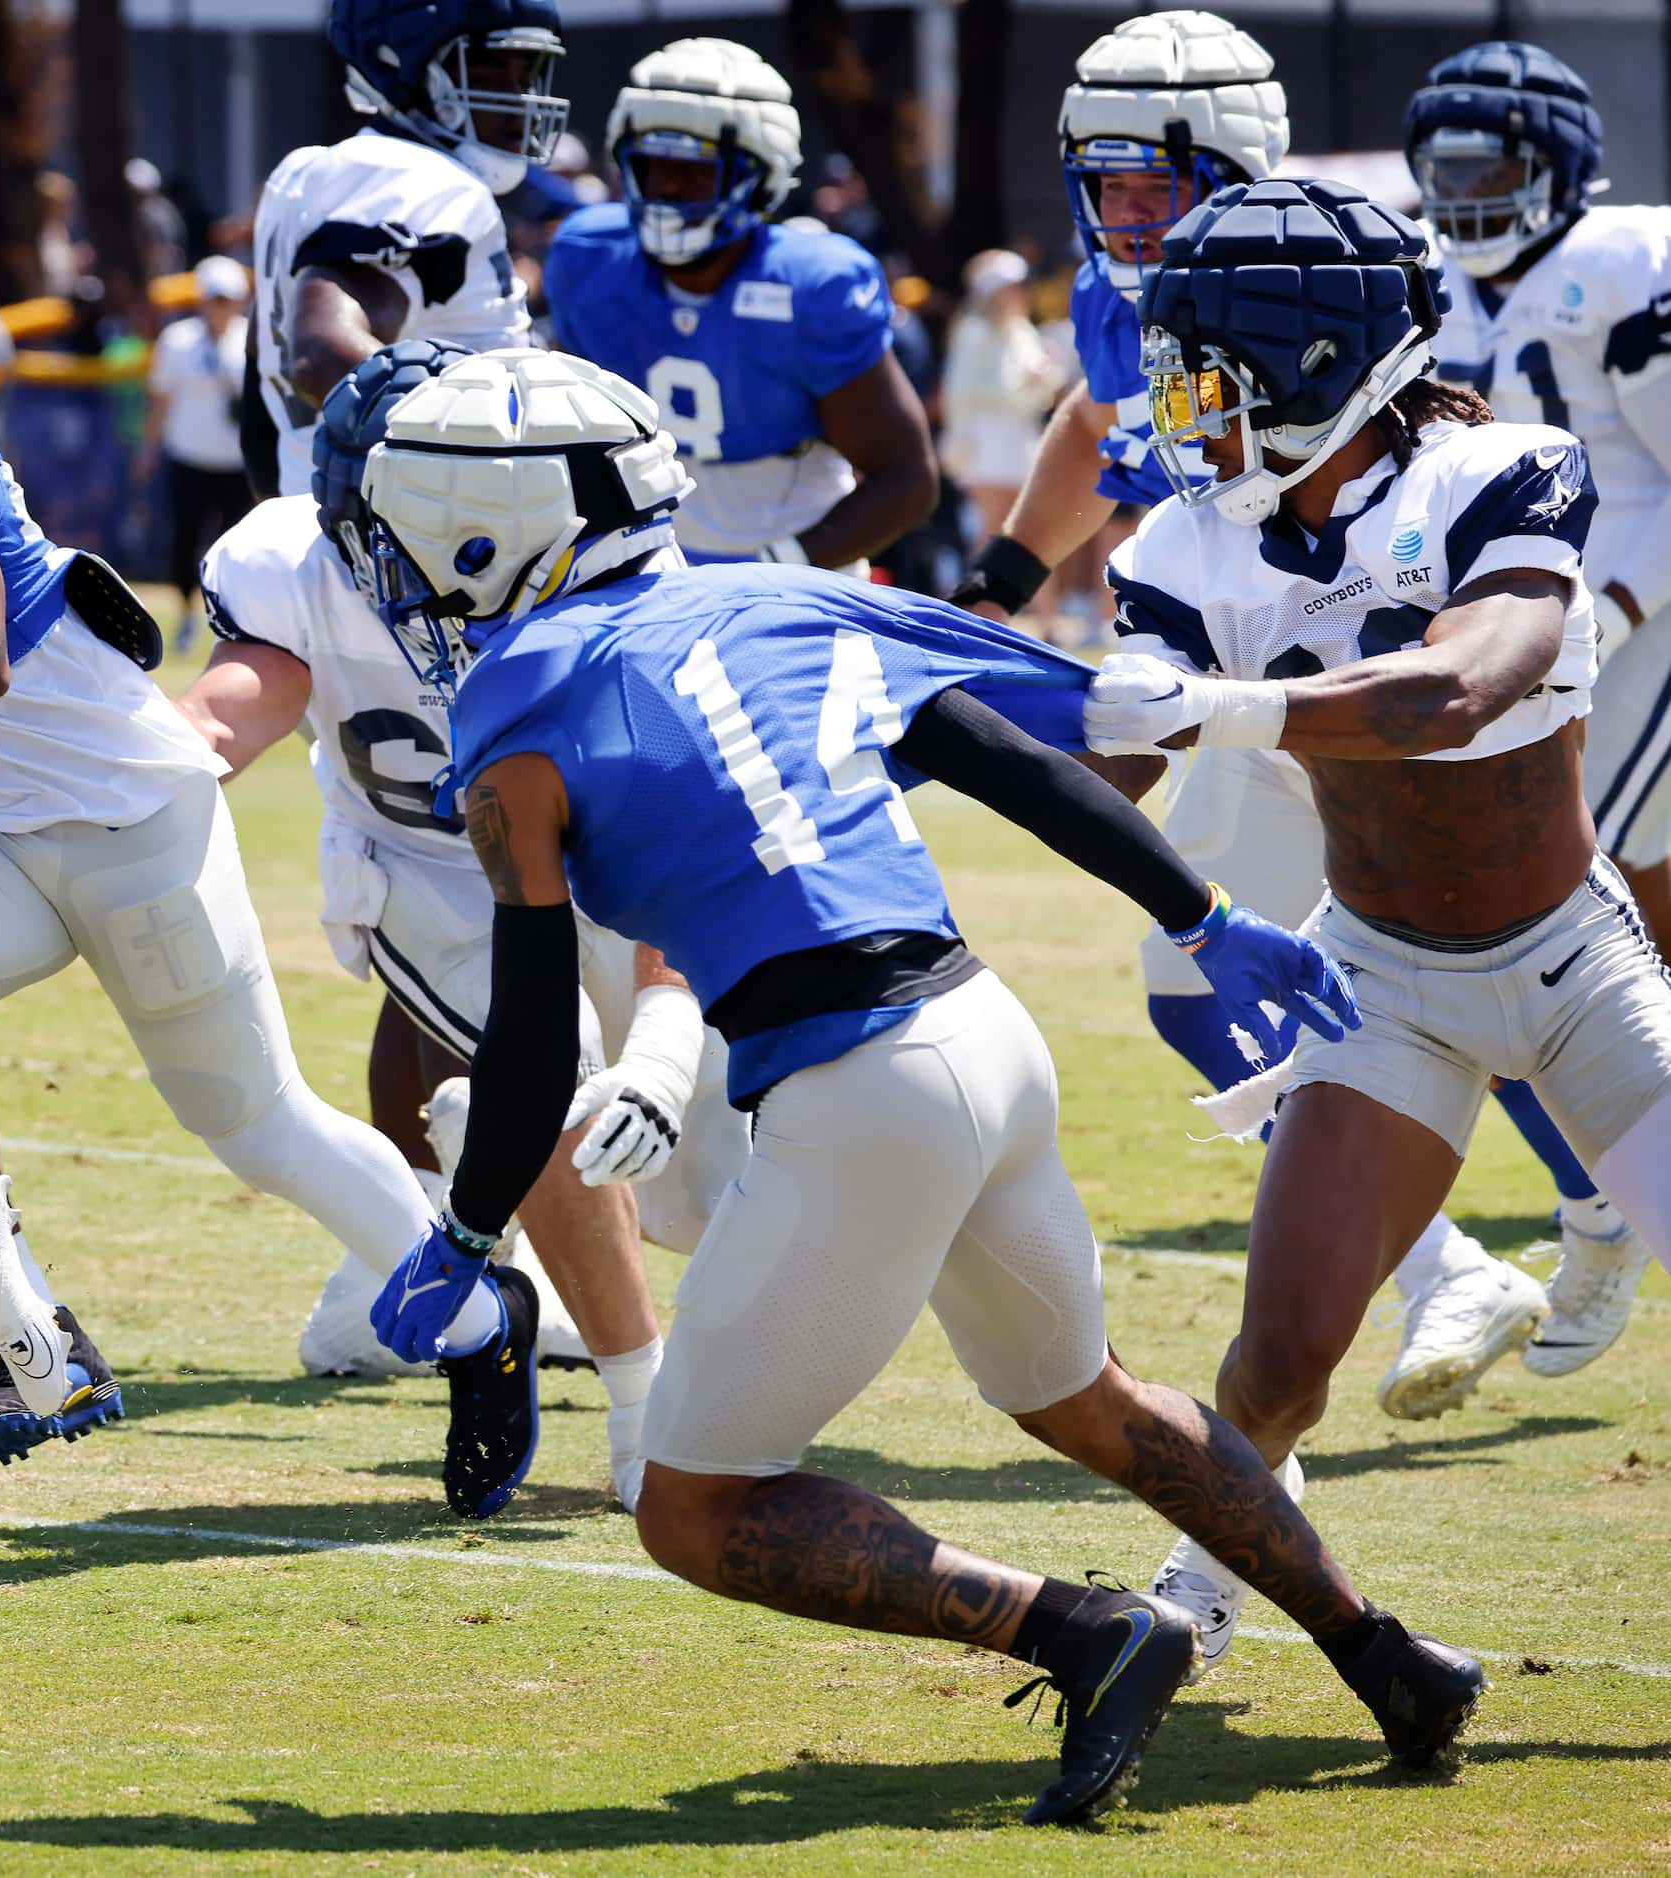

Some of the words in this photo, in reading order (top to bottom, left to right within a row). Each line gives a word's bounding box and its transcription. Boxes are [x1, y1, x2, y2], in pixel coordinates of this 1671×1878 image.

[1395, 566, 1433, 589] AT&T
[1303, 576, 1374, 616] COWBOYS
[672, 627, 923, 877] 14
[1182, 927, 1206, 943] CAMP
